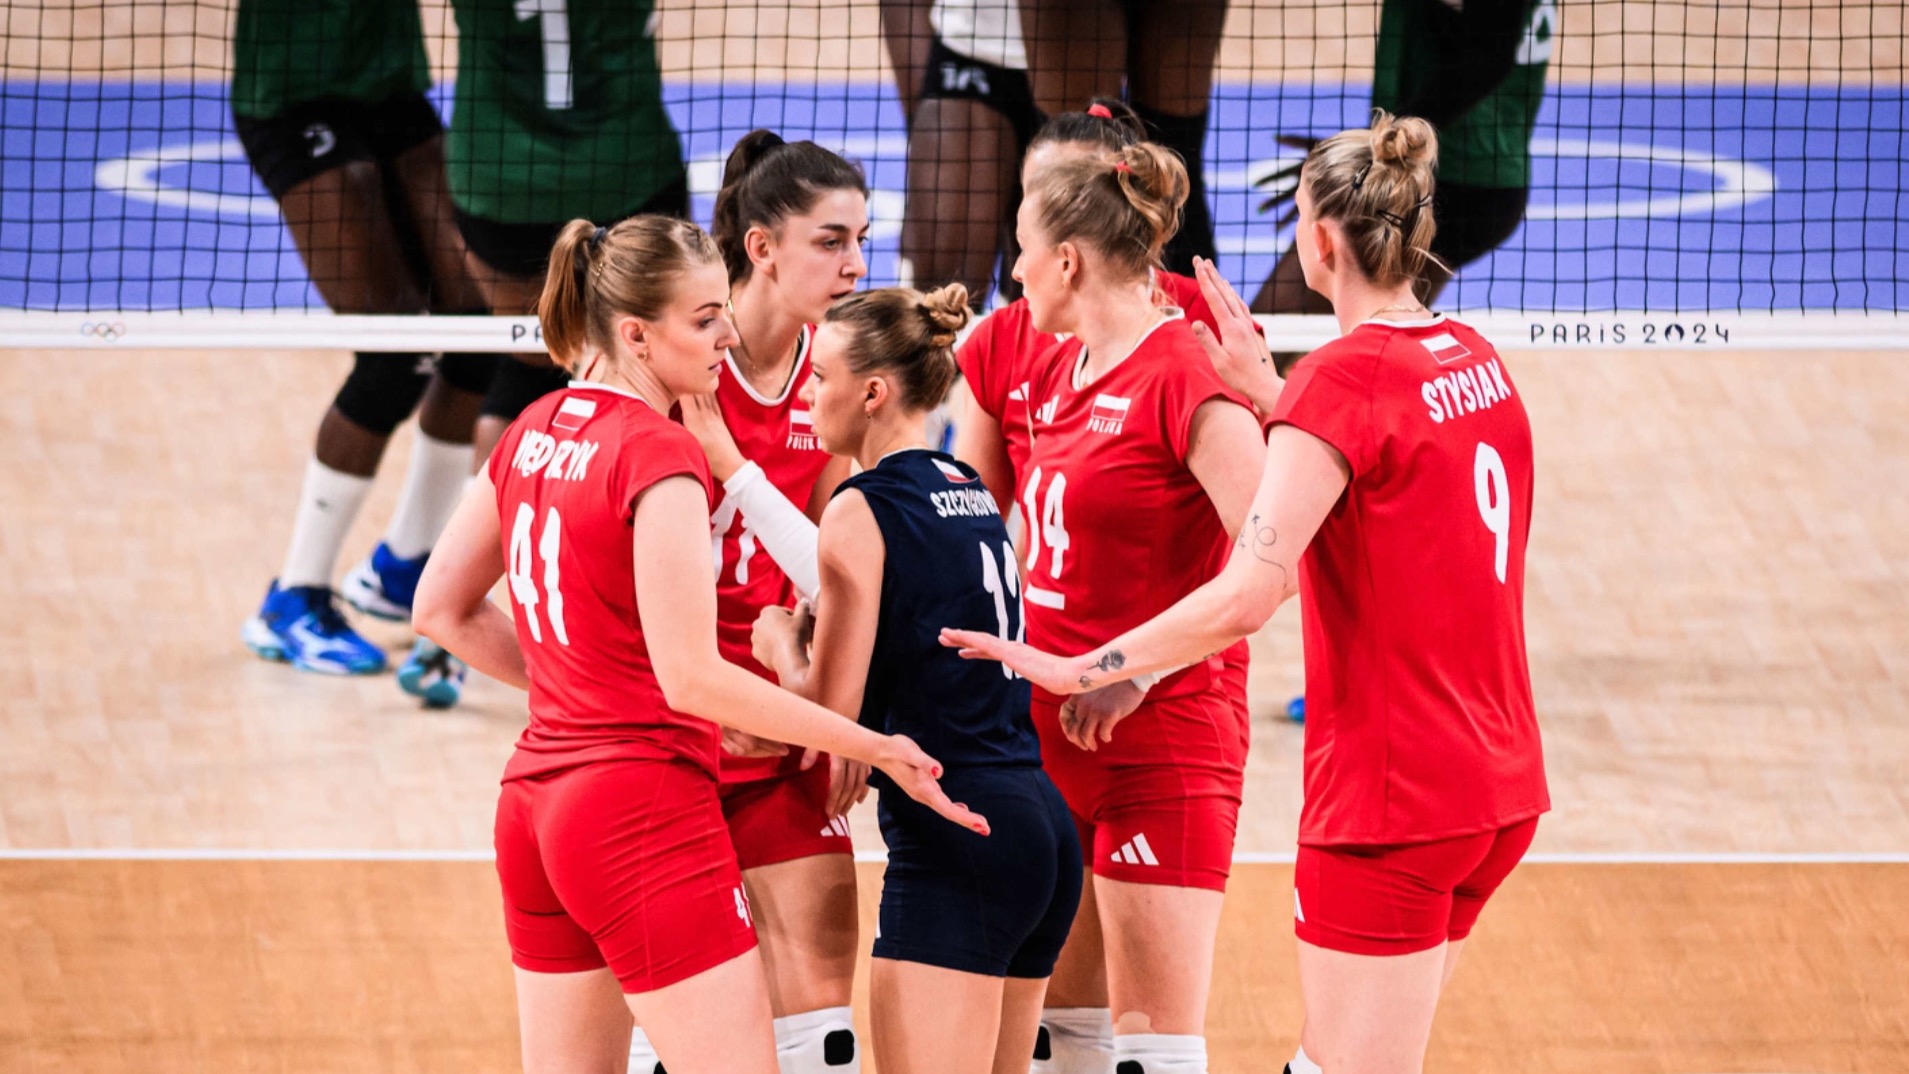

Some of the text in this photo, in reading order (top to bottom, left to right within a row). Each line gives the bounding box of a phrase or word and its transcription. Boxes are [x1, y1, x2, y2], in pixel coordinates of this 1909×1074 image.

[1642, 323, 1730, 344] 2024
[1086, 418, 1122, 436] POLSKA
[1421, 357, 1511, 424] STYSIAK
[1024, 466, 1070, 580] 14
[1474, 441, 1510, 585] 9
[509, 501, 570, 647] 41
